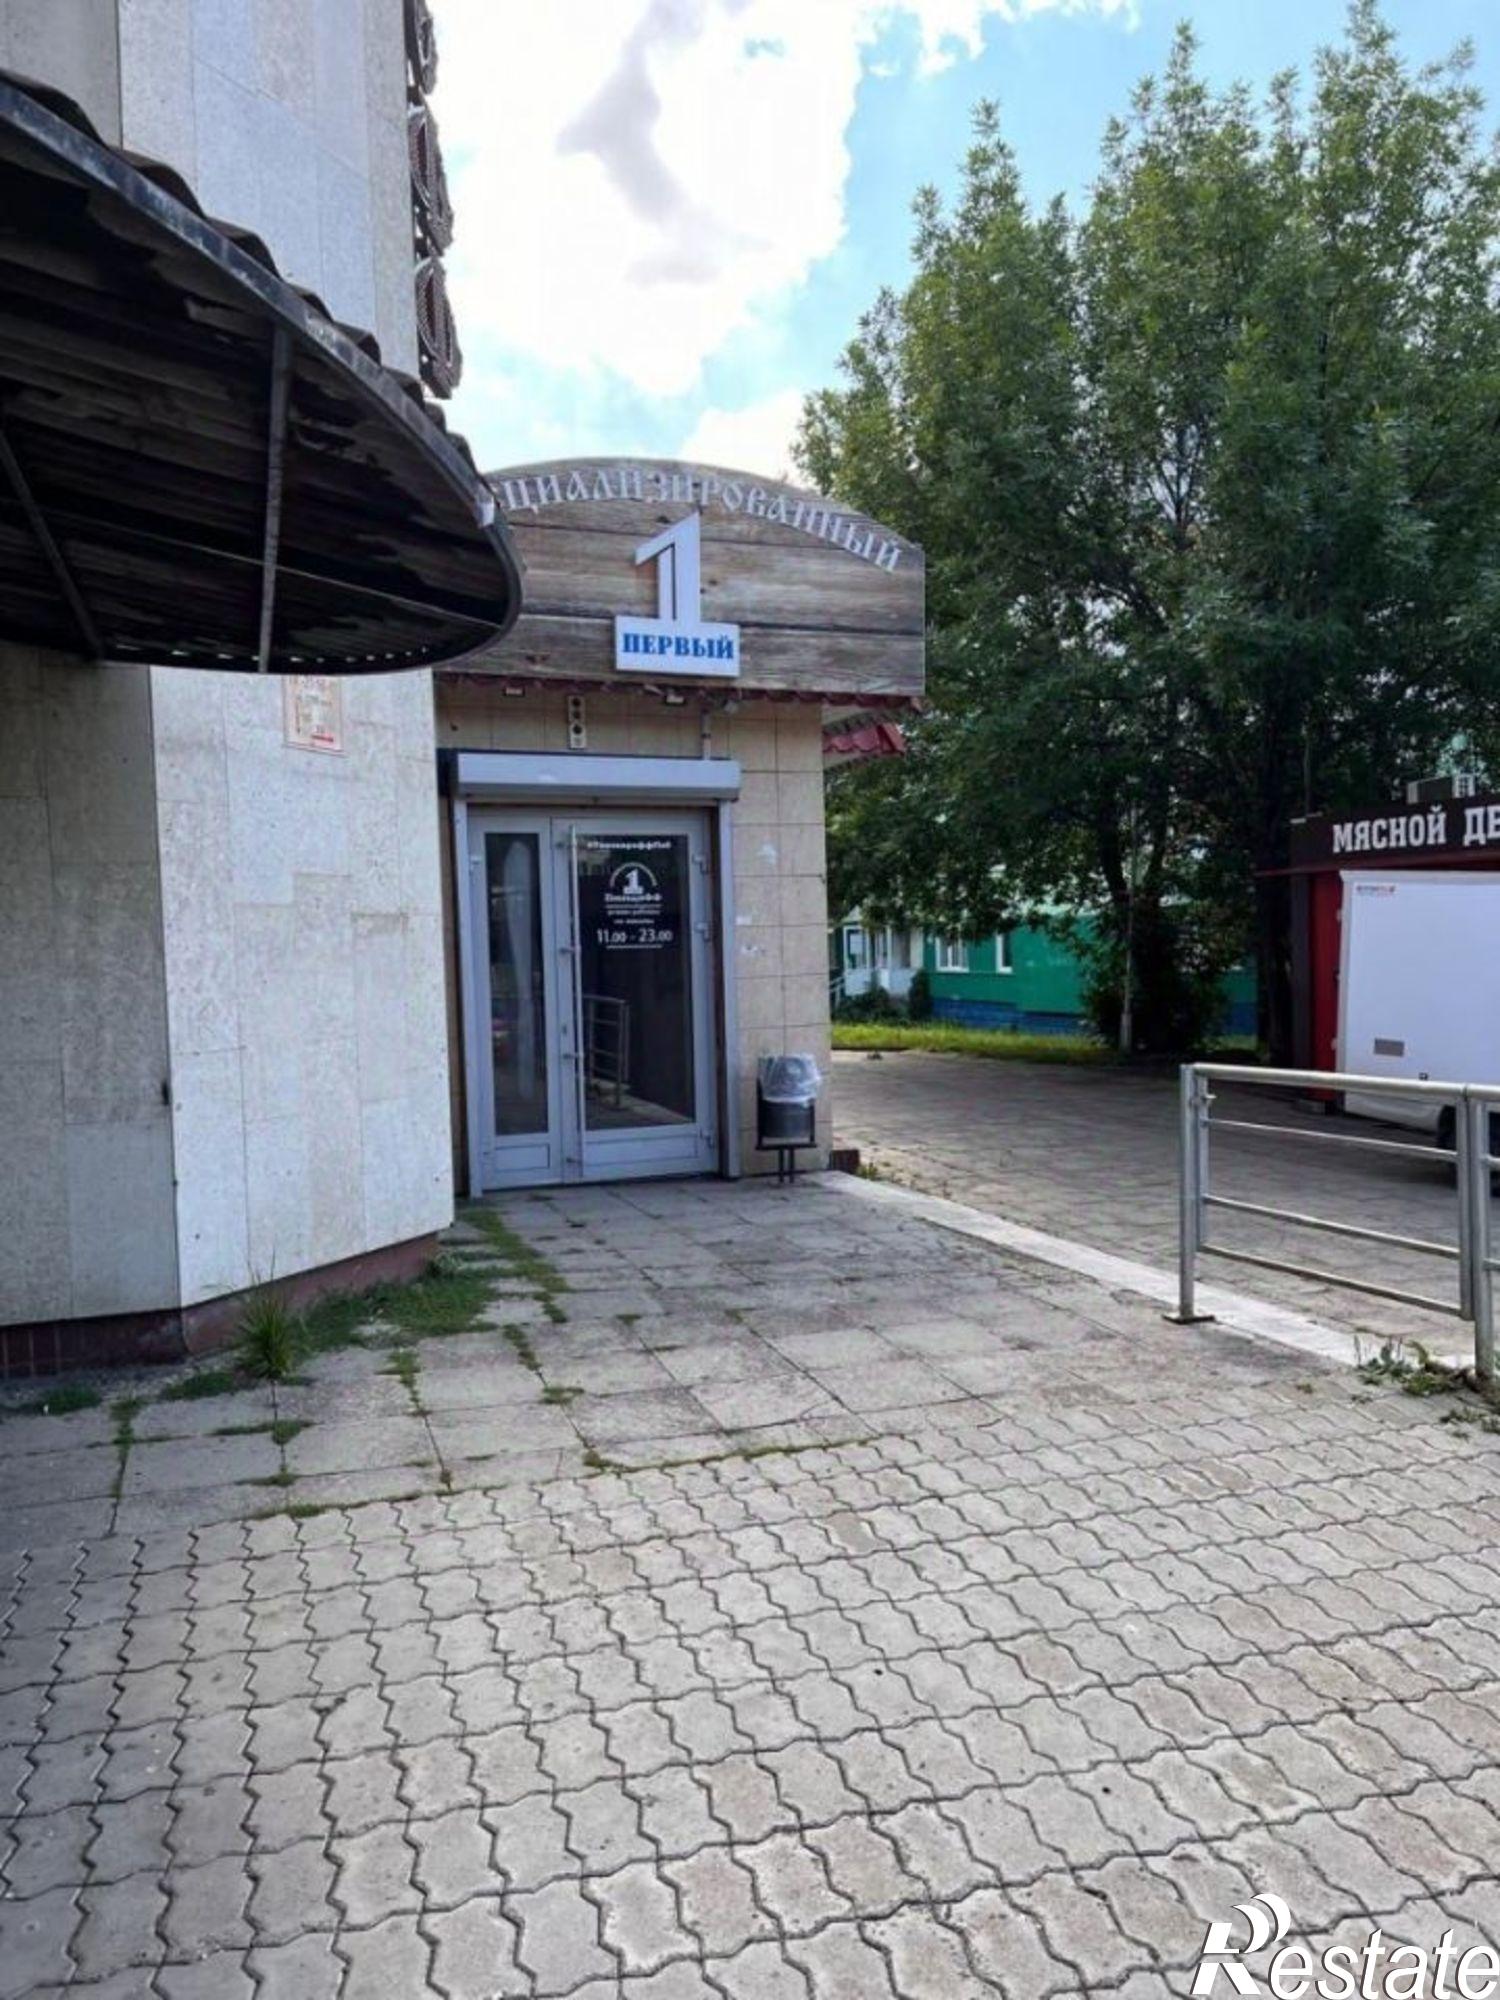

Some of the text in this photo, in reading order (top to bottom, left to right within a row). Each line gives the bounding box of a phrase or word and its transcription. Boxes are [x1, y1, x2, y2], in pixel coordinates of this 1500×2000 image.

[490, 467, 901, 572] ЦИАЛИЗИРОВАННЫЙ
[635, 511, 700, 622] 1
[622, 633, 734, 660] ПЕРВЫЙ
[1332, 804, 1447, 853] МЯСНОЙ
[638, 927, 673, 942] 23.00
